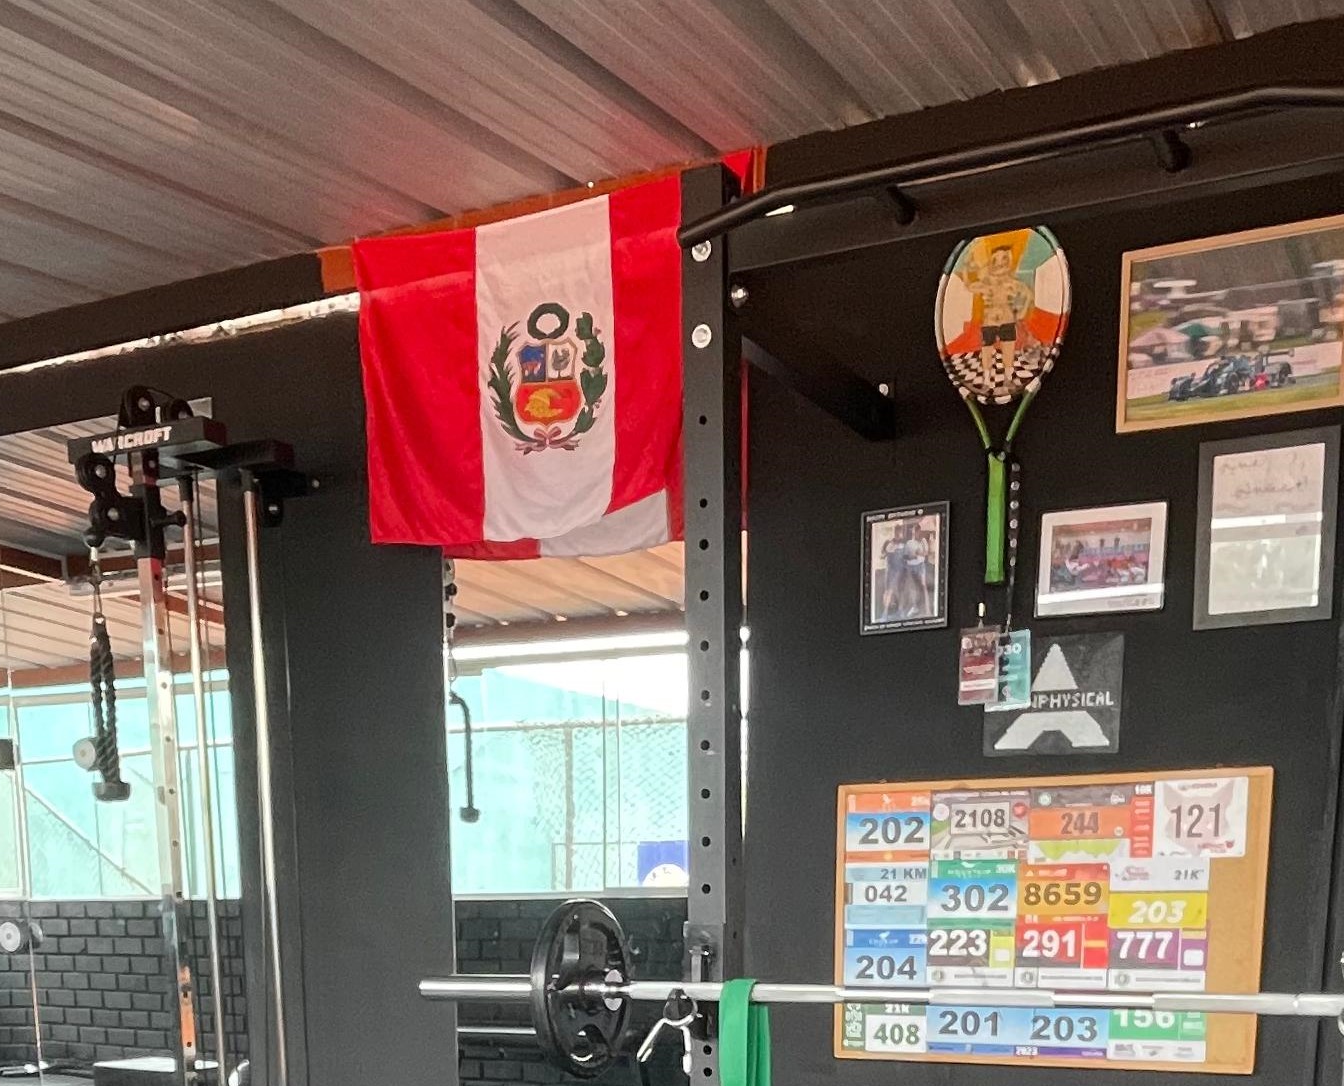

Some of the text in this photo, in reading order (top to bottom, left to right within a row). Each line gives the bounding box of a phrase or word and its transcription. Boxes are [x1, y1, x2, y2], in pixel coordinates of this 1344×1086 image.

[858, 816, 925, 845] 202
[955, 808, 1006, 829] 2108
[1060, 812, 1099, 835] 244
[1170, 803, 1221, 839] 121
[880, 868, 928, 880] 21 KM
[864, 884, 908, 903] 042
[940, 883, 1009, 912] 302
[1024, 881, 1103, 906] 8659
[1127, 900, 1187, 924] 203
[928, 929, 988, 957] 223
[1022, 929, 1076, 958] 291
[1115, 931, 1174, 960] 777
[855, 955, 917, 980] 204
[873, 1023, 920, 1046] 408
[938, 1010, 999, 1037] 201
[1030, 1015, 1098, 1042] 203
